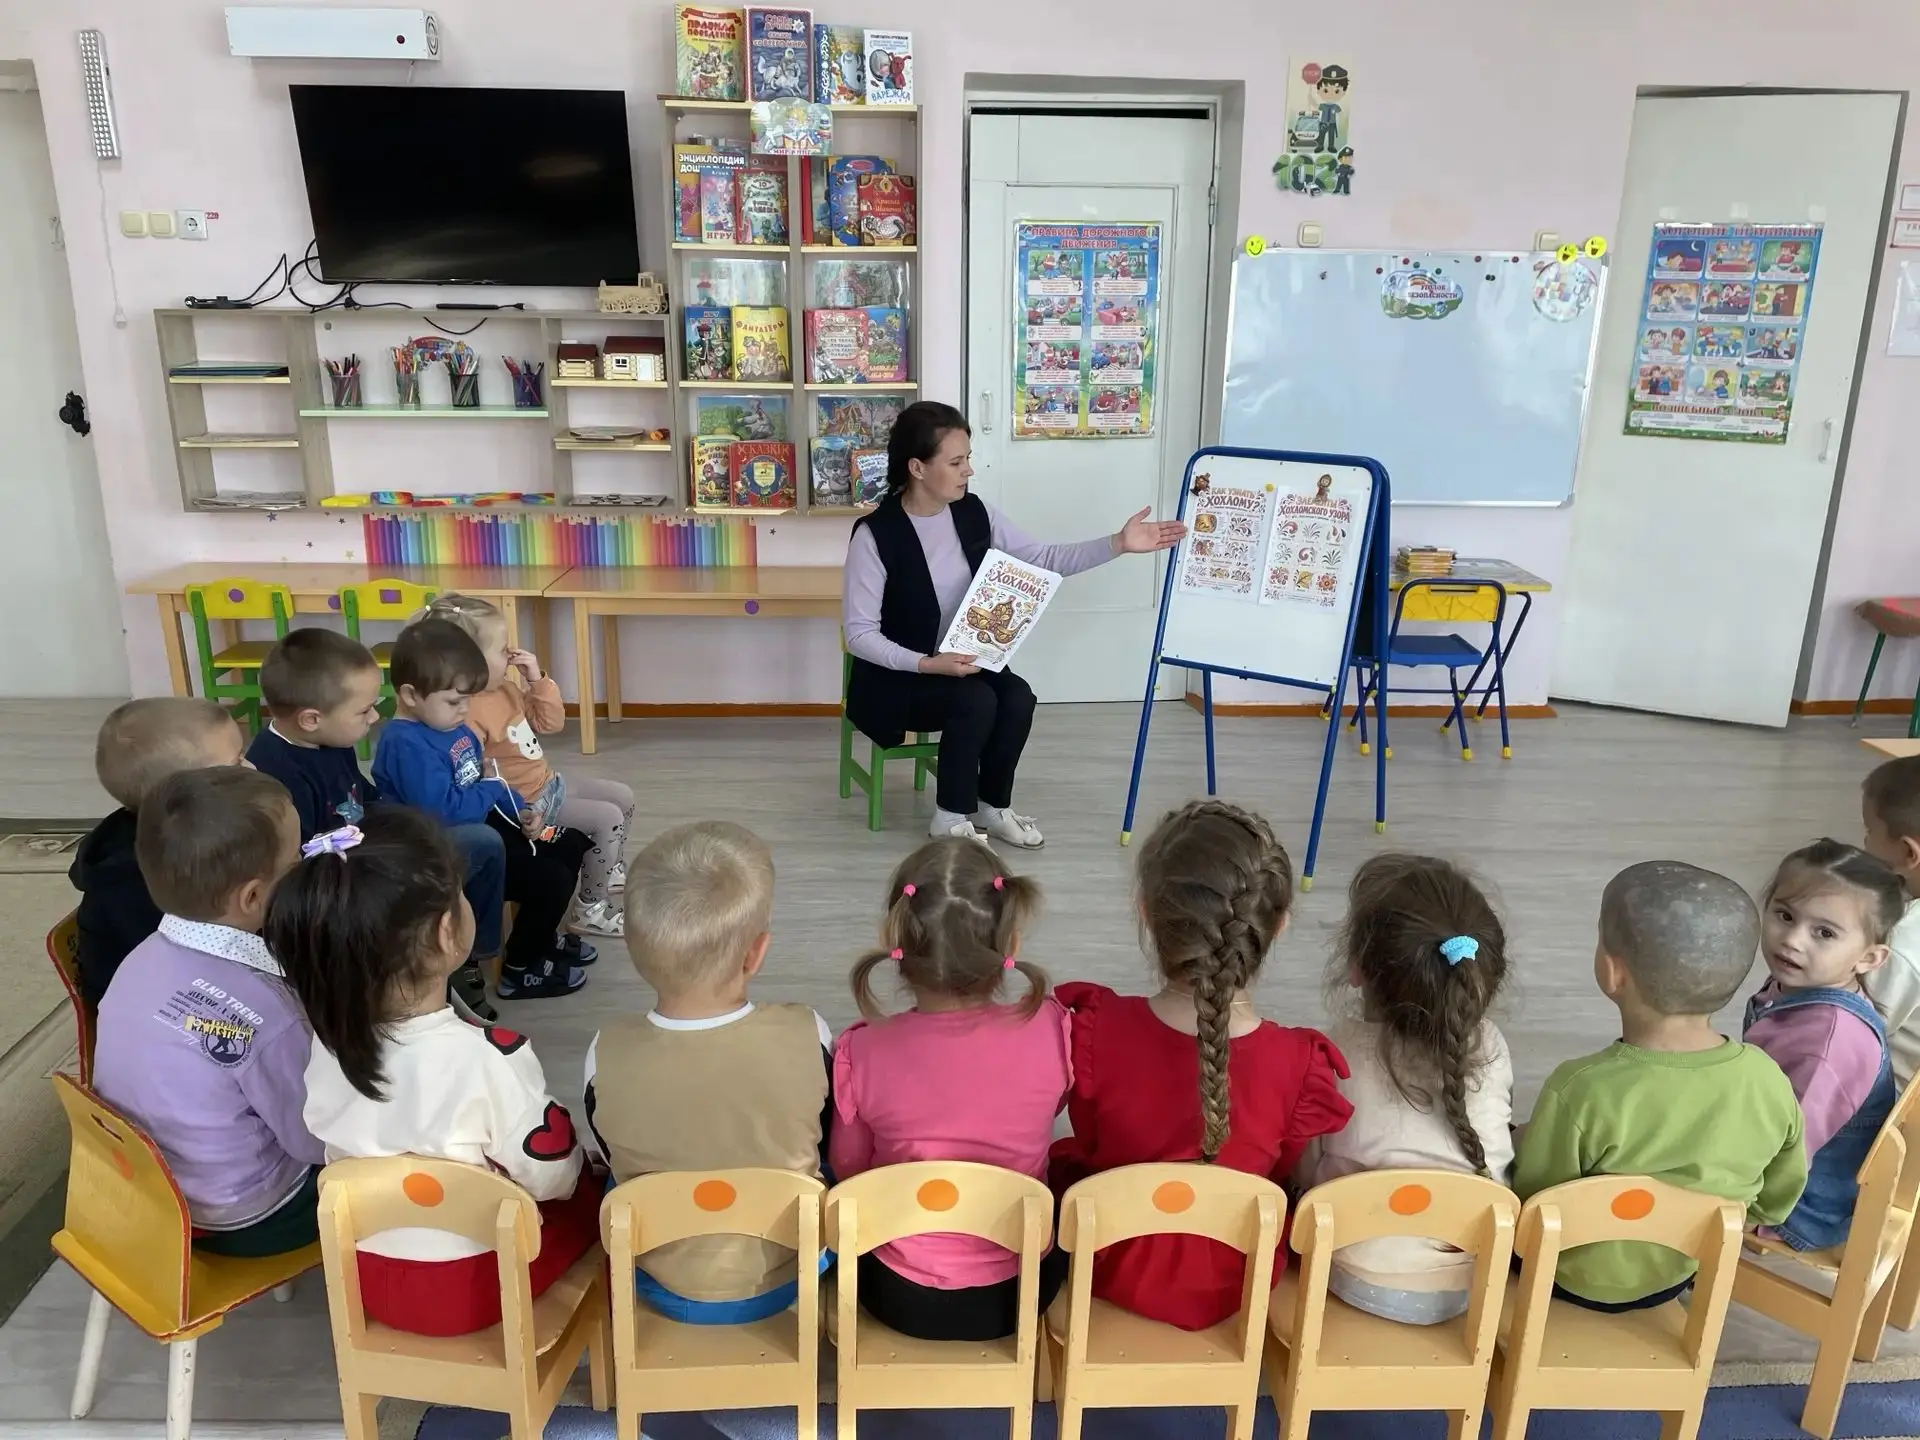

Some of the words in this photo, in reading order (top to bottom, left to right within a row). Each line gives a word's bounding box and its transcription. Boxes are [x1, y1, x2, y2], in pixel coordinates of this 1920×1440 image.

[688, 20, 735, 32] ПРАВИЛА
[688, 29, 736, 39] ПОВЕДЕНИЯ
[871, 87, 911, 102] ВАРЕЖКА
[679, 154, 745, 165] ЭНЦИКЛОПЕДИЯ
[1031, 227, 1078, 238] ПРАВИЛА
[1081, 227, 1147, 238] ДОРОЖНОГО
[1060, 239, 1118, 249] ДВИЖЕНИЯ
[1211, 487, 1226, 495] КАК
[1228, 488, 1255, 499] УЗНАТЬ
[1204, 495, 1260, 512] ХОХЛОМУ?
[1278, 505, 1328, 517] ХОХЛОМСКОГО
[1329, 511, 1350, 523] УЗОРА
[1004, 562, 1043, 586] ЗОЛОТАЯ
[988, 570, 1045, 602] ХОХЛОМА
[191, 978, 227, 999] BLND
[226, 996, 264, 1025] TREND
